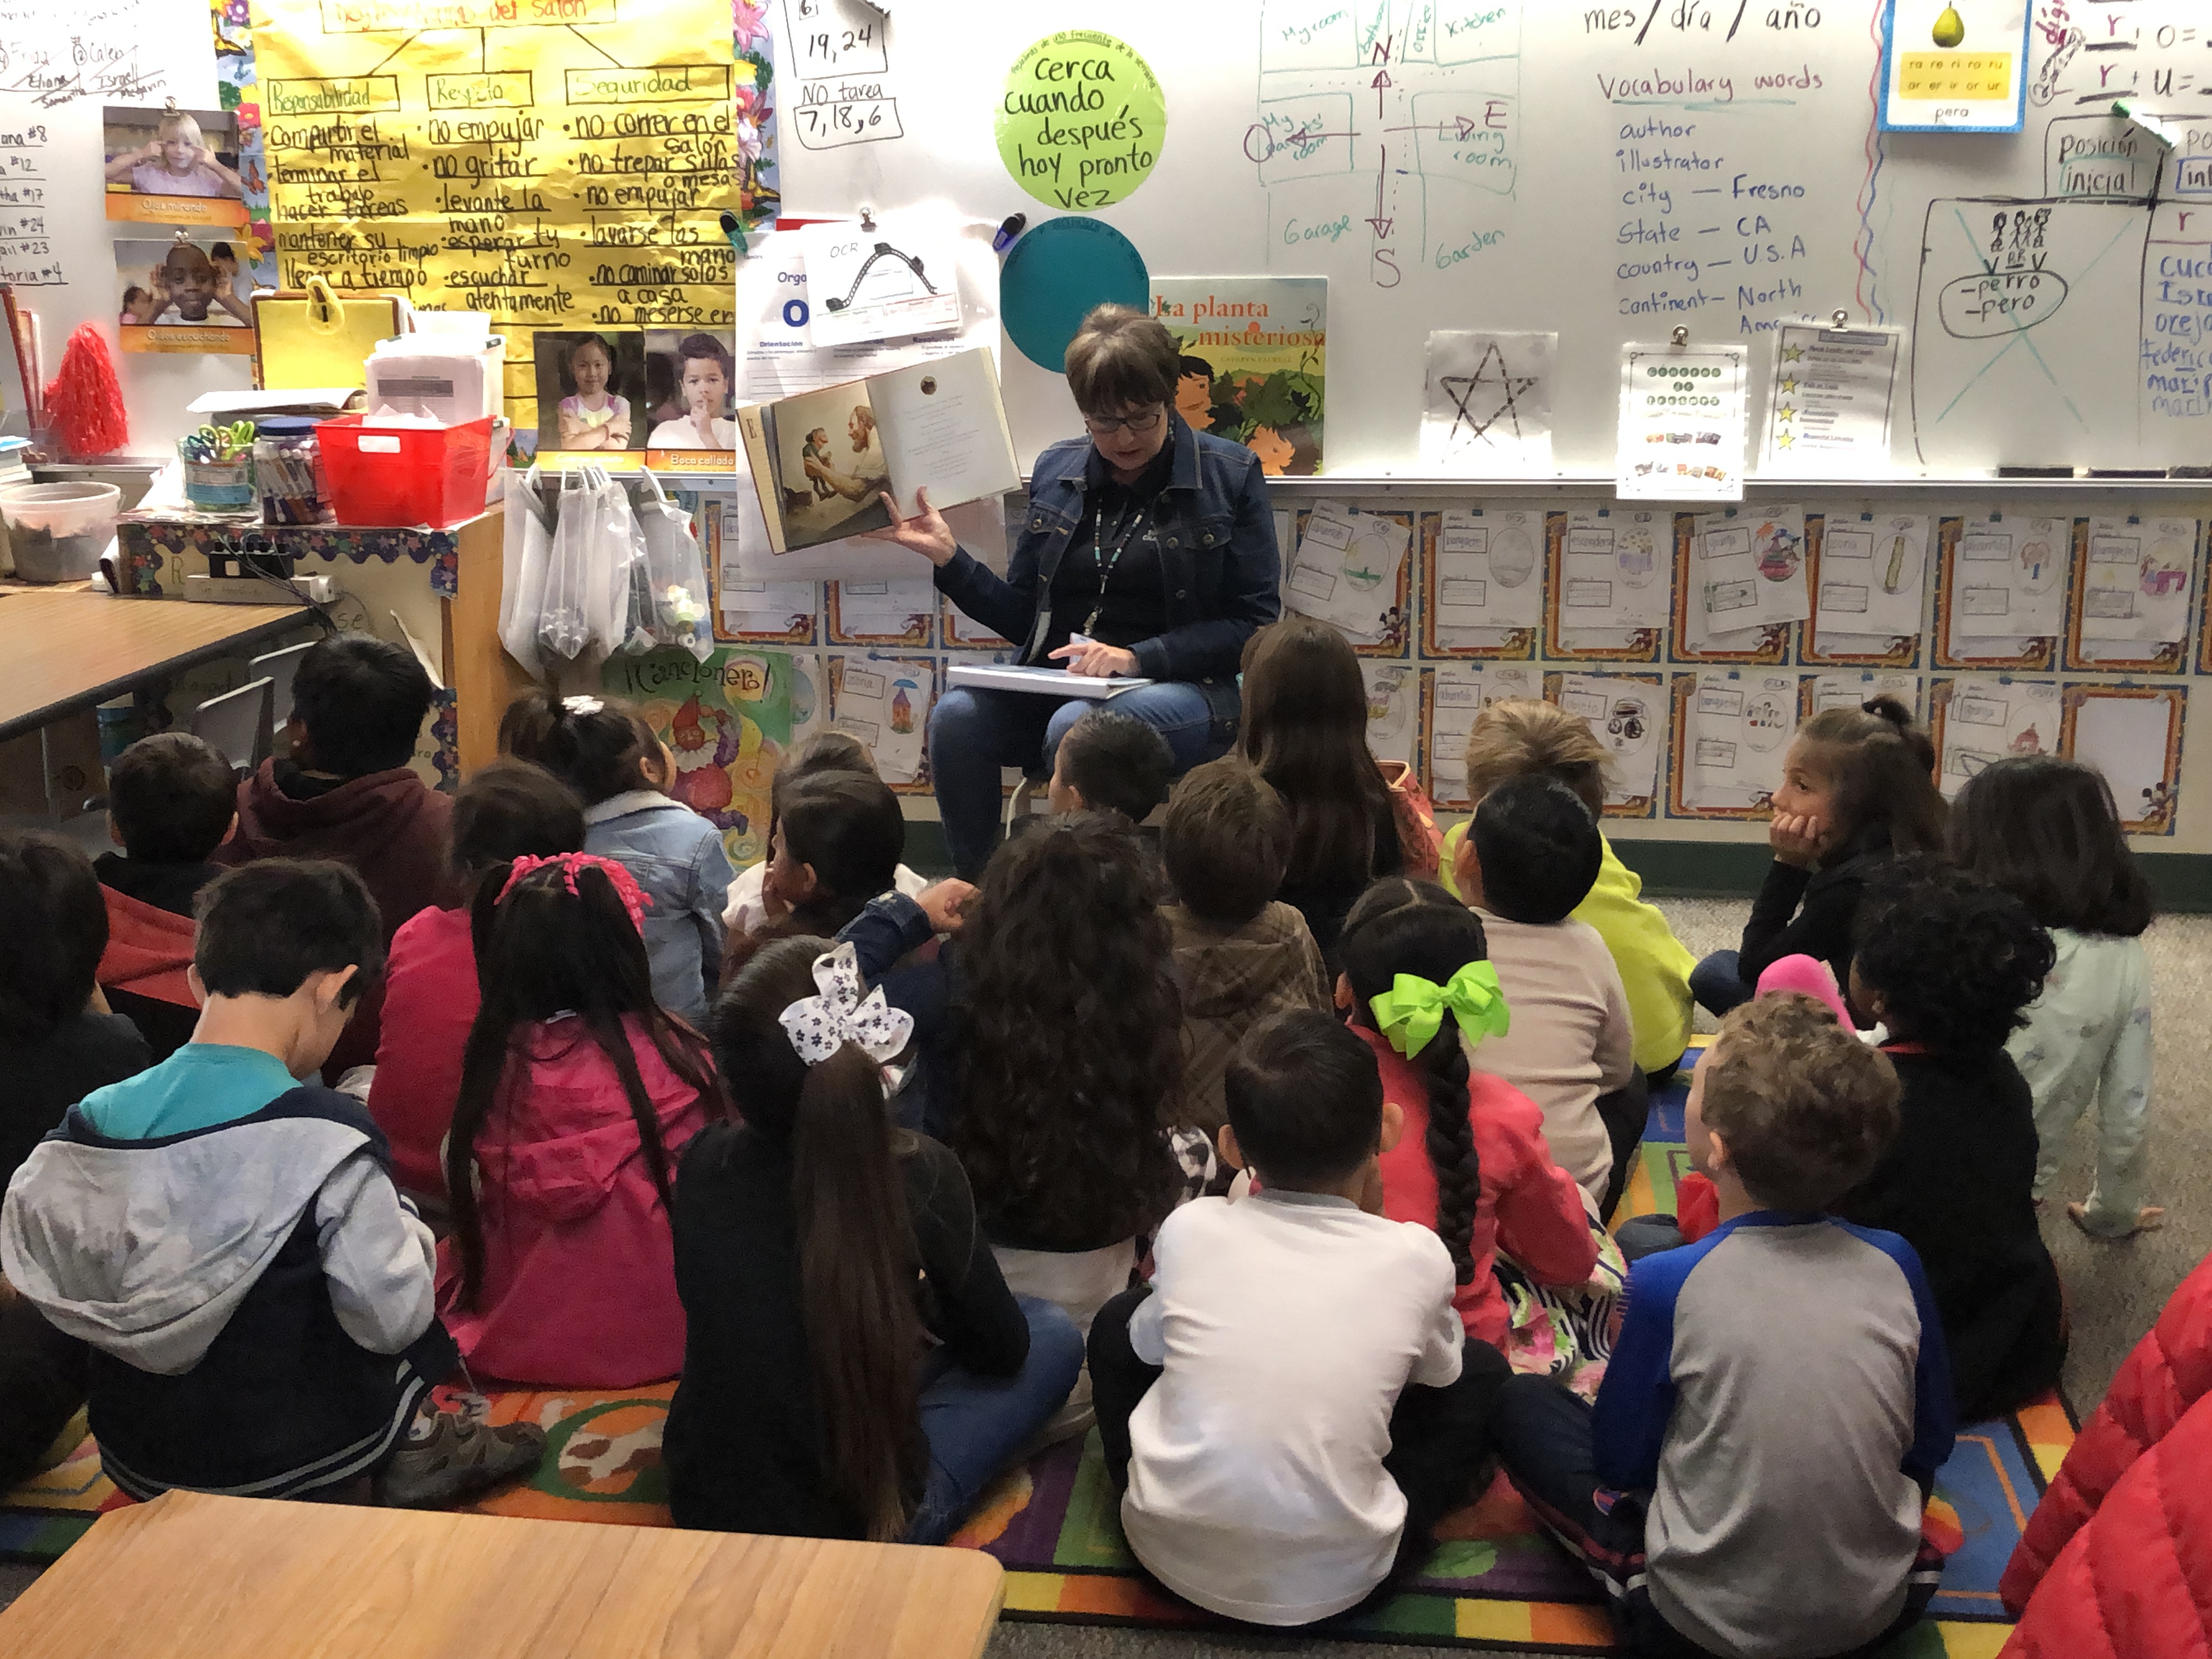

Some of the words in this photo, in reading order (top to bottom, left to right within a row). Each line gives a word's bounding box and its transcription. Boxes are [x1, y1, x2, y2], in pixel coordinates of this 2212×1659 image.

[1765, 1, 1821, 31] año
[1372, 34, 1393, 66] N
[575, 66, 692, 105] Seguridad
[838, 81, 884, 102] tarea
[1754, 64, 1824, 91] words
[575, 113, 604, 139] no
[613, 112, 678, 136] correr
[714, 105, 730, 134] el
[1037, 104, 1143, 151] después
[1485, 100, 1510, 129] E
[1620, 115, 1697, 140] author
[1934, 108, 1970, 125] pera
[361, 116, 379, 143] el
[429, 117, 451, 145] no
[458, 111, 544, 157] empujar
[1438, 119, 1505, 153] Living
[329, 132, 409, 164] material
[578, 153, 603, 174] no
[685, 149, 742, 170] sillas
[1453, 150, 1513, 170] room
[1615, 147, 1725, 173] illustrator
[358, 160, 381, 182] el
[433, 156, 457, 178] no
[465, 148, 539, 189] gritar
[1018, 143, 1062, 184] hoy
[1079, 142, 1153, 188] pronto
[2066, 162, 2135, 194] inicial
[681, 171, 742, 188] mesas
[444, 183, 511, 212] levante
[523, 184, 544, 210] la
[586, 184, 609, 207] no
[614, 185, 702, 219] empujar
[1622, 181, 1673, 215] city
[1731, 173, 1807, 200] Fresno
[343, 198, 409, 219] tareas
[449, 214, 505, 234] mano
[591, 215, 659, 246] lavarse
[1284, 214, 1353, 245] Garage
[1736, 215, 1773, 237] CA
[364, 231, 386, 250] su
[830, 242, 859, 258] OCR
[307, 250, 392, 267] escritorio
[505, 250, 571, 273] turno
[1375, 247, 1402, 288] S
[1616, 253, 1700, 282] country
[450, 266, 529, 290] escuchar
[596, 264, 617, 284] no
[680, 264, 729, 282] solos
[466, 284, 575, 314] atentamente
[617, 289, 631, 304] a
[637, 287, 688, 306] casa
[1618, 287, 1709, 315] continent
[1737, 278, 1803, 310] North
[599, 305, 622, 325] no
[782, 298, 810, 328] O
[1155, 295, 1186, 318] La
[1192, 295, 1270, 325] planta
[1199, 325, 1327, 347] misteriosa
[670, 454, 697, 465] Boca
[698, 454, 734, 466] callada
